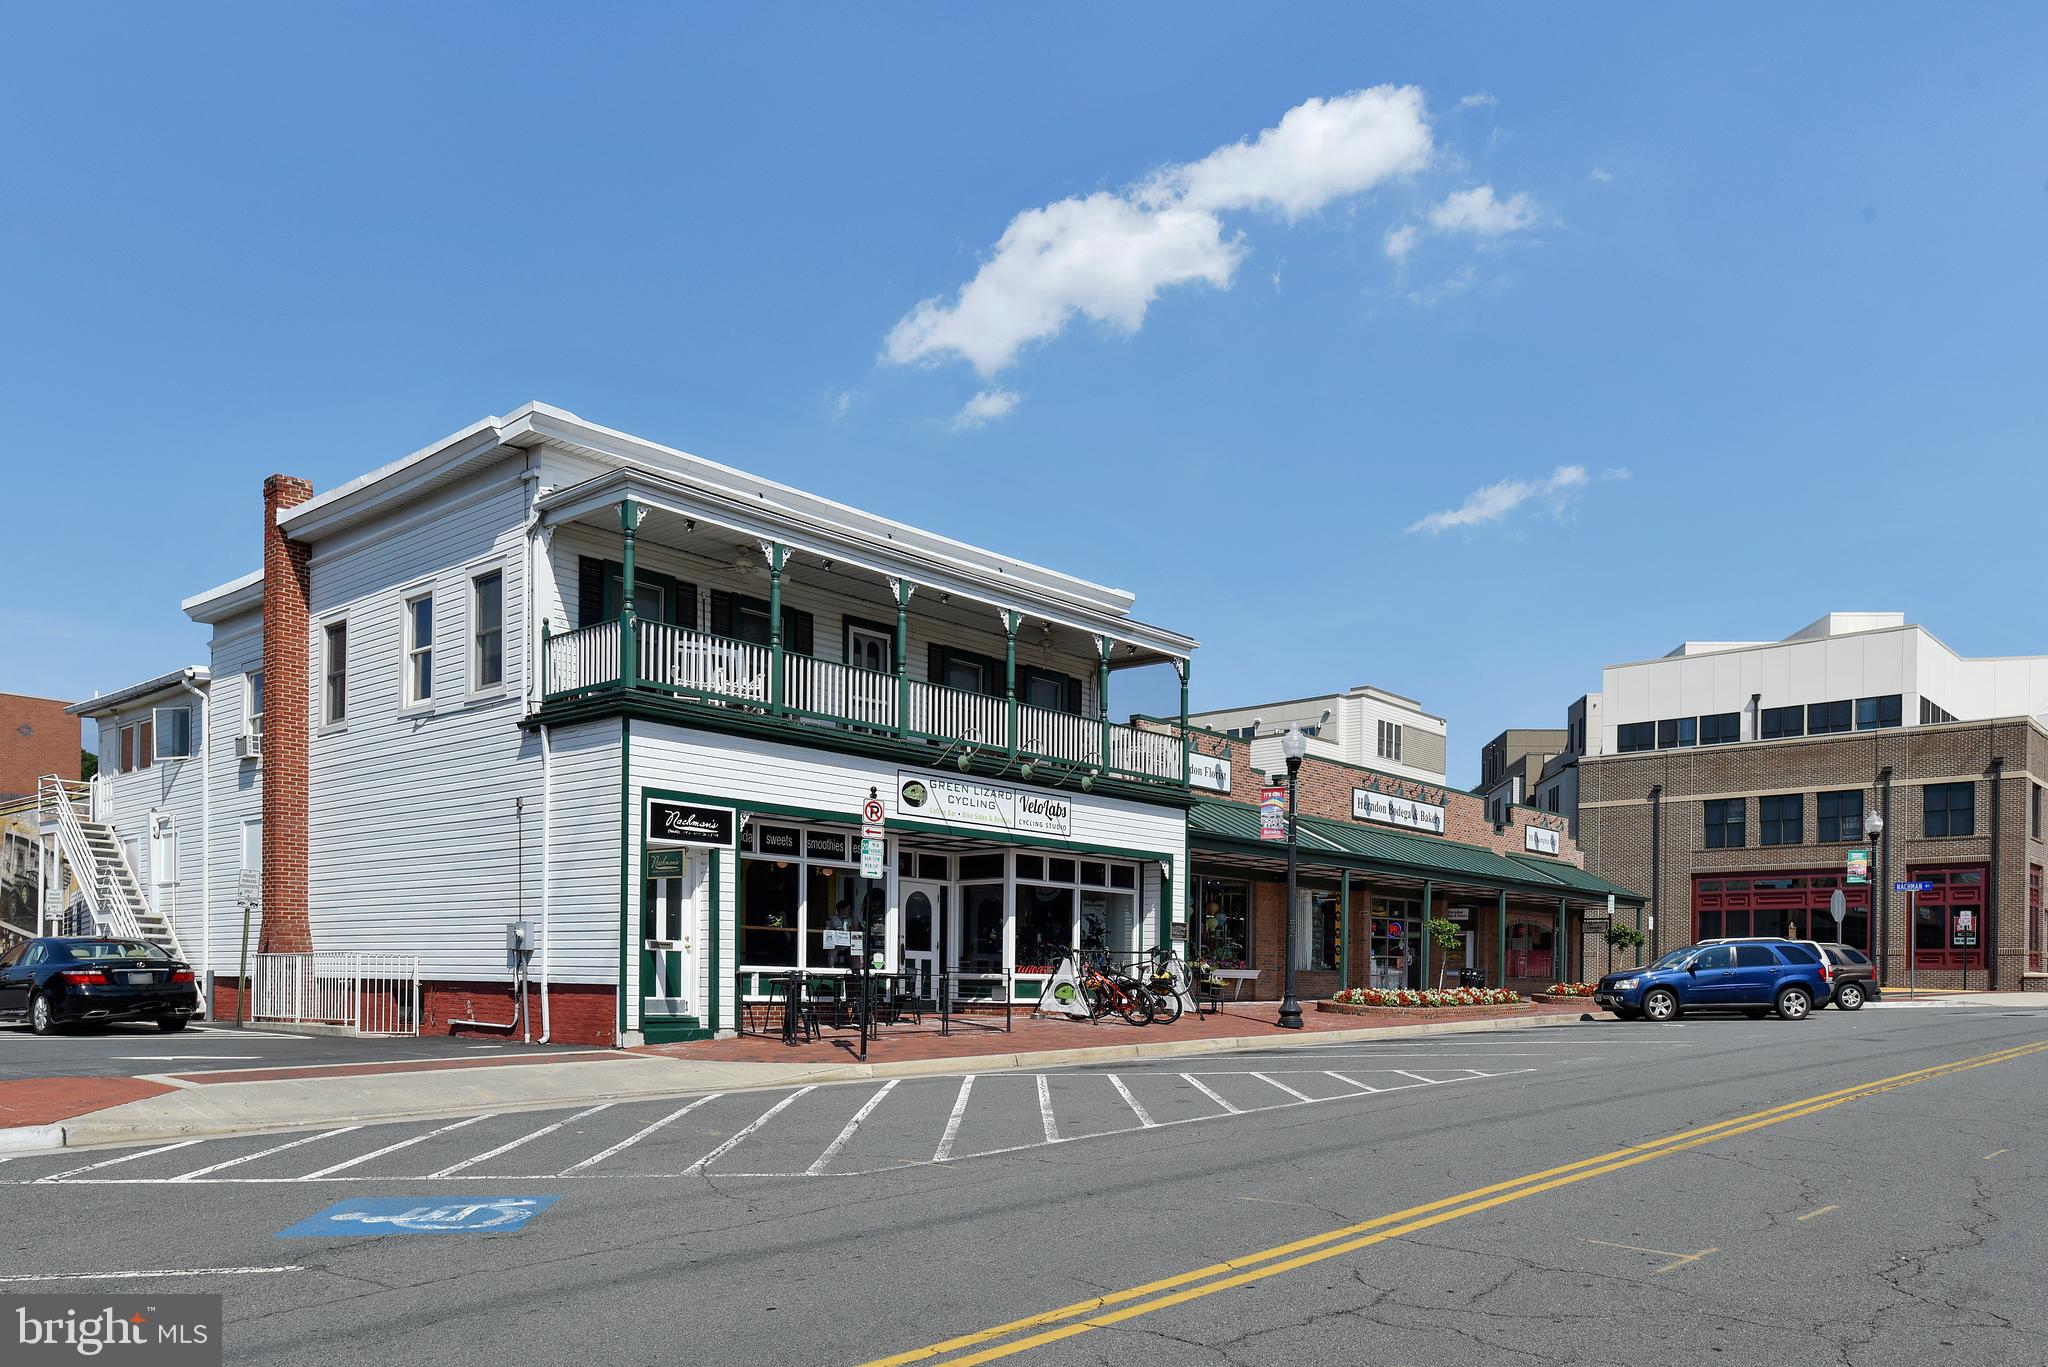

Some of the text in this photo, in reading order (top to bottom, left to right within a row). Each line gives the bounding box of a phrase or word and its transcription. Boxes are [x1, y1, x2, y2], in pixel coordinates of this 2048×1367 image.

[1204, 766, 1226, 780] Florist
[930, 780, 1012, 800] GREEN LIZARD
[948, 795, 996, 810] CYCLING
[1020, 796, 1066, 821] VeloLabs
[1358, 797, 1386, 814] Herndon
[1388, 804, 1411, 820] Bodega
[974, 813, 988, 822] Sales
[1018, 819, 1044, 828] CYCLING
[766, 834, 793, 847] sweets
[807, 839, 844, 852] smoothies
